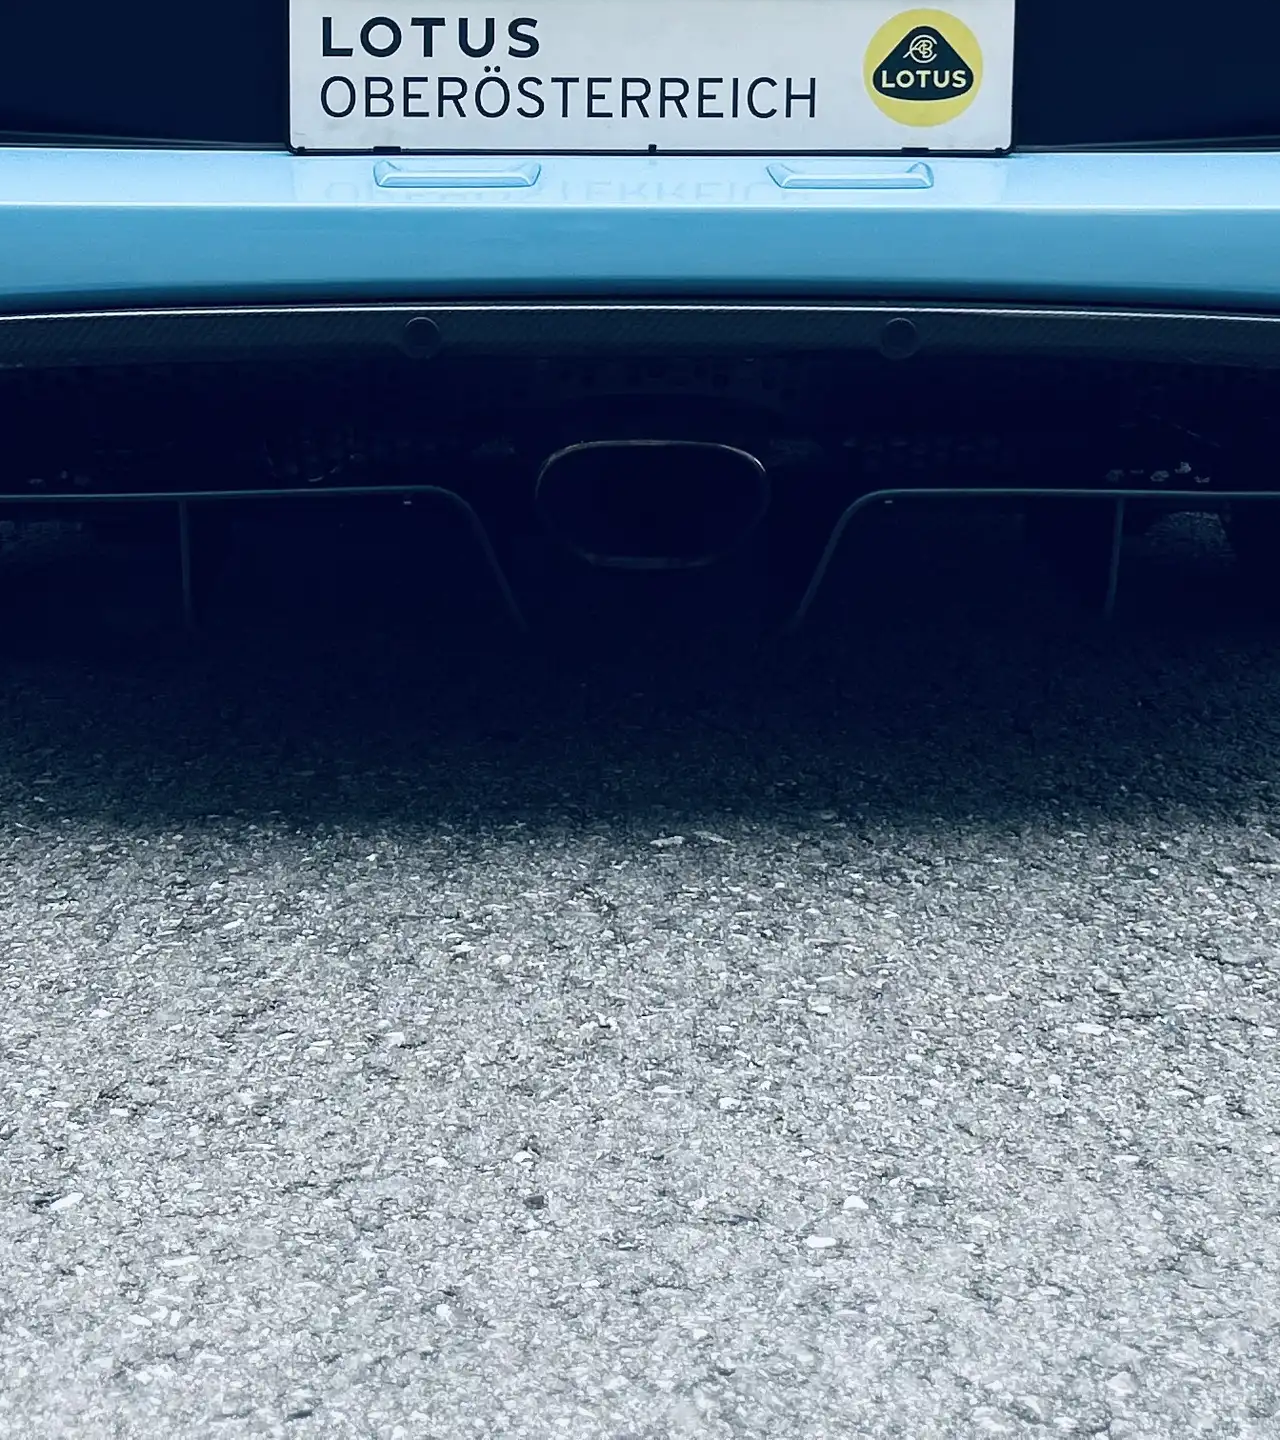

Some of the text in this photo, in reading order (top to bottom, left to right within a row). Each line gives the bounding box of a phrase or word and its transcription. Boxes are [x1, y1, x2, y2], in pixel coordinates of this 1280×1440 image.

[322, 16, 541, 59] LOTUS
[320, 65, 817, 119] OBERÖSTERREICH
[881, 69, 967, 88] LOTUS
